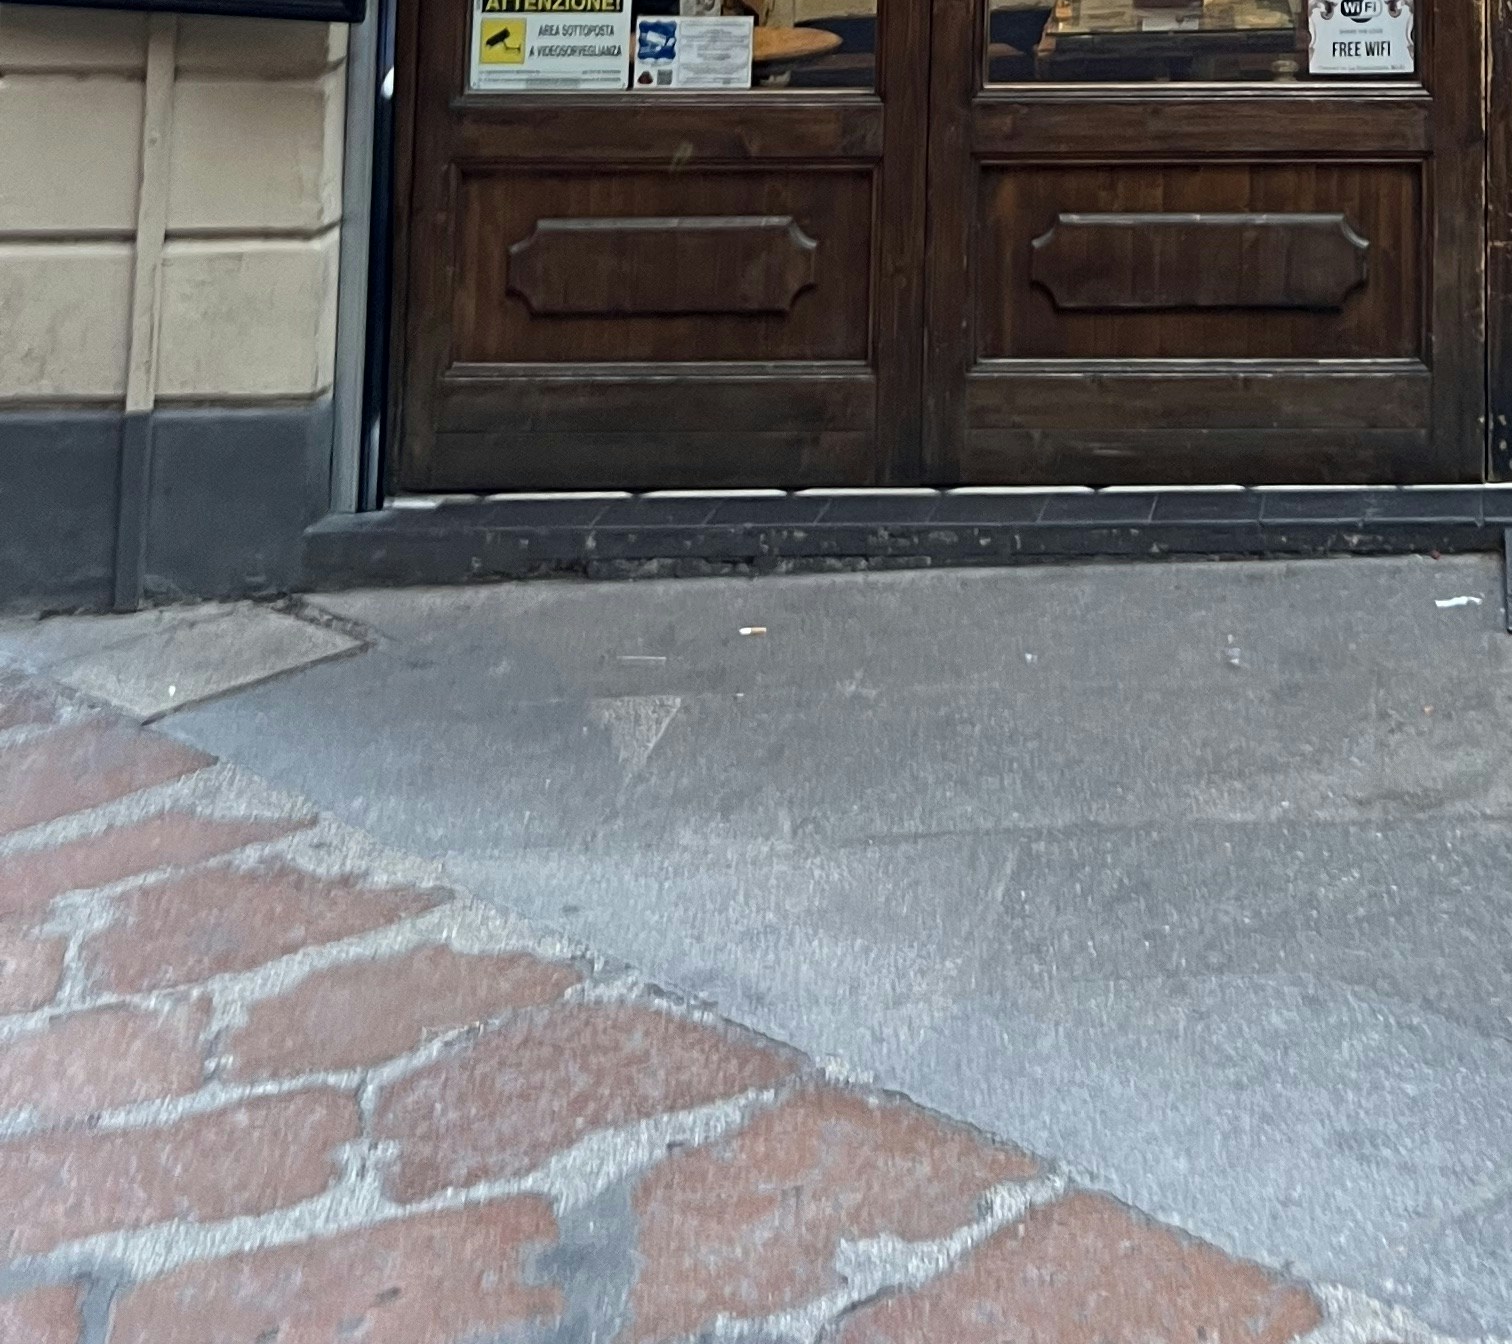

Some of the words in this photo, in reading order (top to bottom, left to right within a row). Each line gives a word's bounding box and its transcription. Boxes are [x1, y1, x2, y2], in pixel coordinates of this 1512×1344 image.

[538, 24, 560, 37] AREA
[562, 24, 615, 37] SOTTOPOSTA
[528, 45, 536, 57] A
[1332, 40, 1362, 57] FREE
[1364, 40, 1391, 56] WIFI
